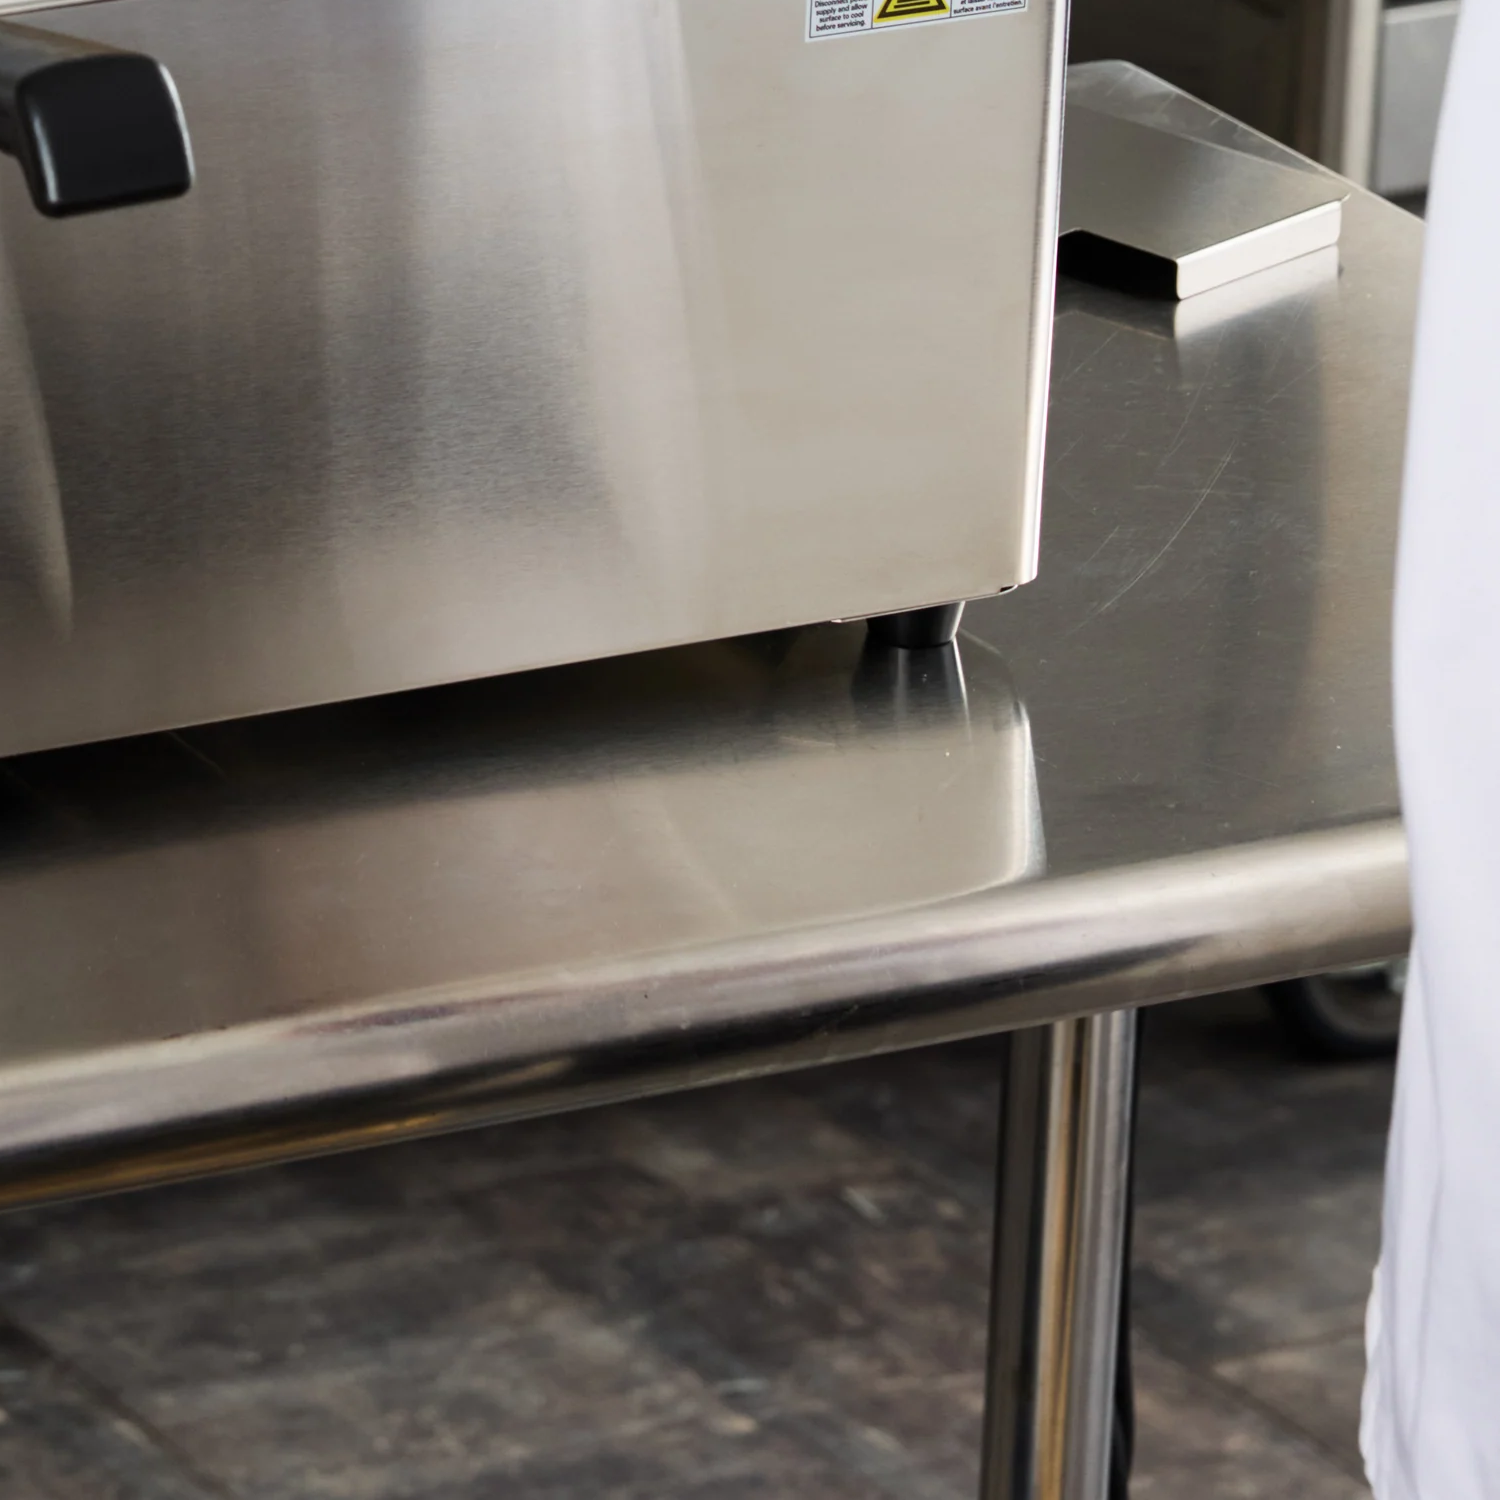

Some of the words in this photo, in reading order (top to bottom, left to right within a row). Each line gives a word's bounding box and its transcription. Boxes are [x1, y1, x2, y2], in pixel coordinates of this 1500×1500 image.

[816, 7, 836, 16] supply
[819, 14, 841, 23] surface
[816, 23, 836, 32] before
